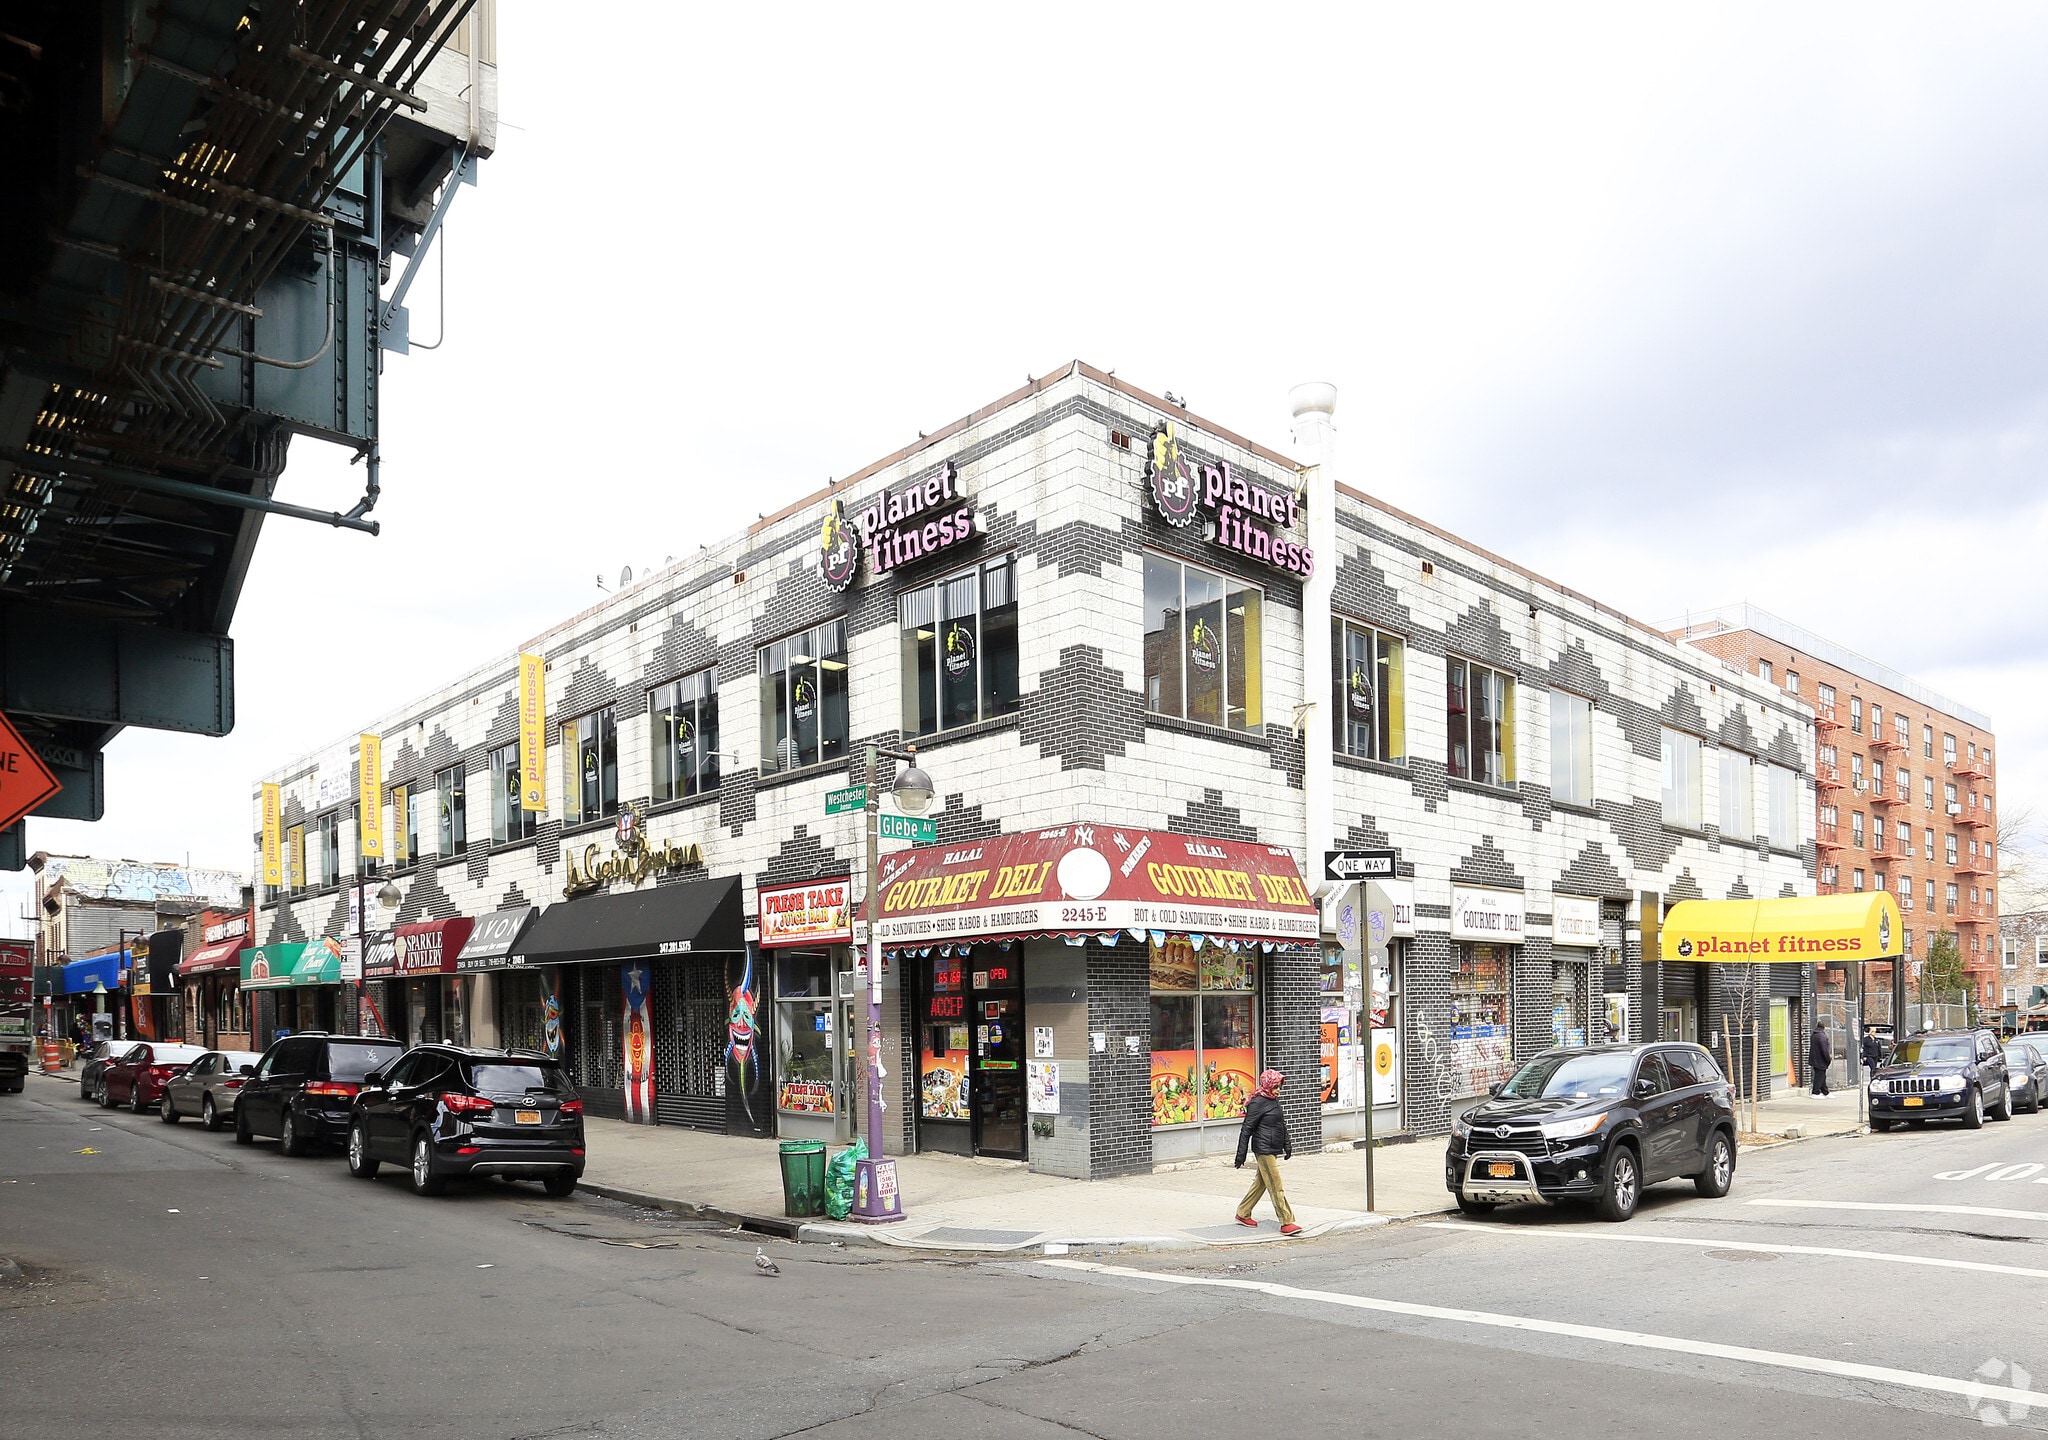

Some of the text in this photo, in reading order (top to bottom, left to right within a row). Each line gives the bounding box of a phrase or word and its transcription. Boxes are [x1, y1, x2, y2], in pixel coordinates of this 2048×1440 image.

[861, 460, 957, 548] planet
[1202, 461, 1300, 529] planet
[871, 506, 975, 574] fitness
[1217, 509, 1315, 577] fitness
[946, 653, 966, 666] planet
[1191, 648, 1212, 660] planet
[1194, 655, 1216, 669] fitness
[949, 660, 970, 672] fitness
[525, 663, 540, 782] planet fitness
[365, 743, 378, 831] planet fitness
[827, 788, 865, 806] Westchester
[266, 789, 277, 863] planet fitness
[883, 816, 932, 838] Glebe Av
[944, 847, 983, 865] HALAL
[1183, 842, 1228, 859] HALAL
[1337, 859, 1386, 871] ONE WAY
[884, 861, 1053, 912] GOURMET DELI
[1146, 861, 1311, 907] GOURMET DELI
[766, 887, 844, 914] FRESH TAKE
[780, 908, 829, 927] JUICE BAR
[892, 920, 932, 936] SANDWICHES
[936, 919, 956, 931] SHISH
[958, 916, 981, 930] KABOB
[982, 915, 988, 927] &
[990, 909, 1039, 928] HAMBURGERS
[1062, 906, 1107, 922] 2245-E
[1134, 908, 1317, 933] HOT & COLD SANDWICHES SHISH KABOB & HAMBURGERS
[1463, 910, 1522, 932] GOURMET DELI
[468, 915, 525, 943] AVON
[407, 931, 443, 952] SPARKLE
[1696, 935, 1862, 957] planet fitness
[407, 949, 443, 969] JEWELERY
[974, 973, 987, 987] EXIT
[989, 968, 1007, 980] OPEN
[930, 996, 964, 1017] ACCEP
[808, 1084, 827, 1097] TAKE
[879, 1187, 897, 1196] 0007
